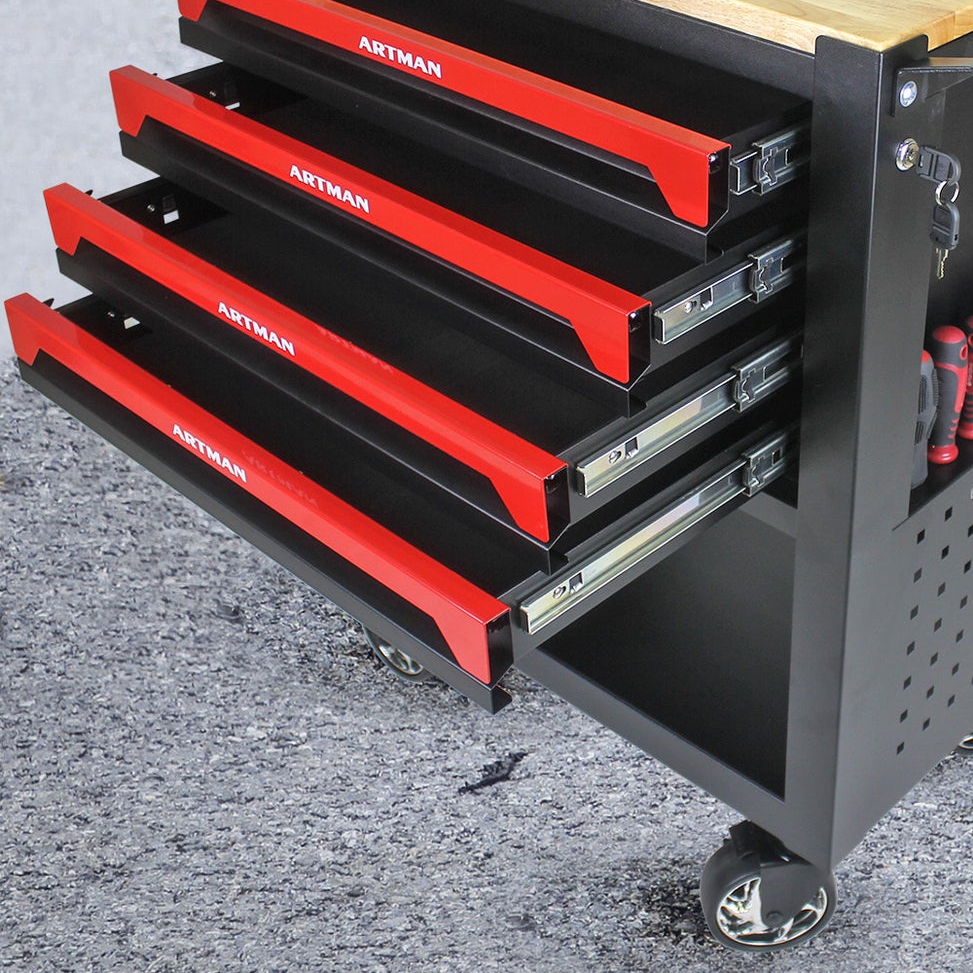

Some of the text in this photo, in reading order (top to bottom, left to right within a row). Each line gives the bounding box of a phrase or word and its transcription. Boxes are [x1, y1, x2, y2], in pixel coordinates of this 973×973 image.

[358, 35, 442, 79] ARTMAN
[289, 164, 370, 214] ARTMAN
[218, 301, 295, 356] ARTMAN
[172, 423, 247, 483] ARTMAN
